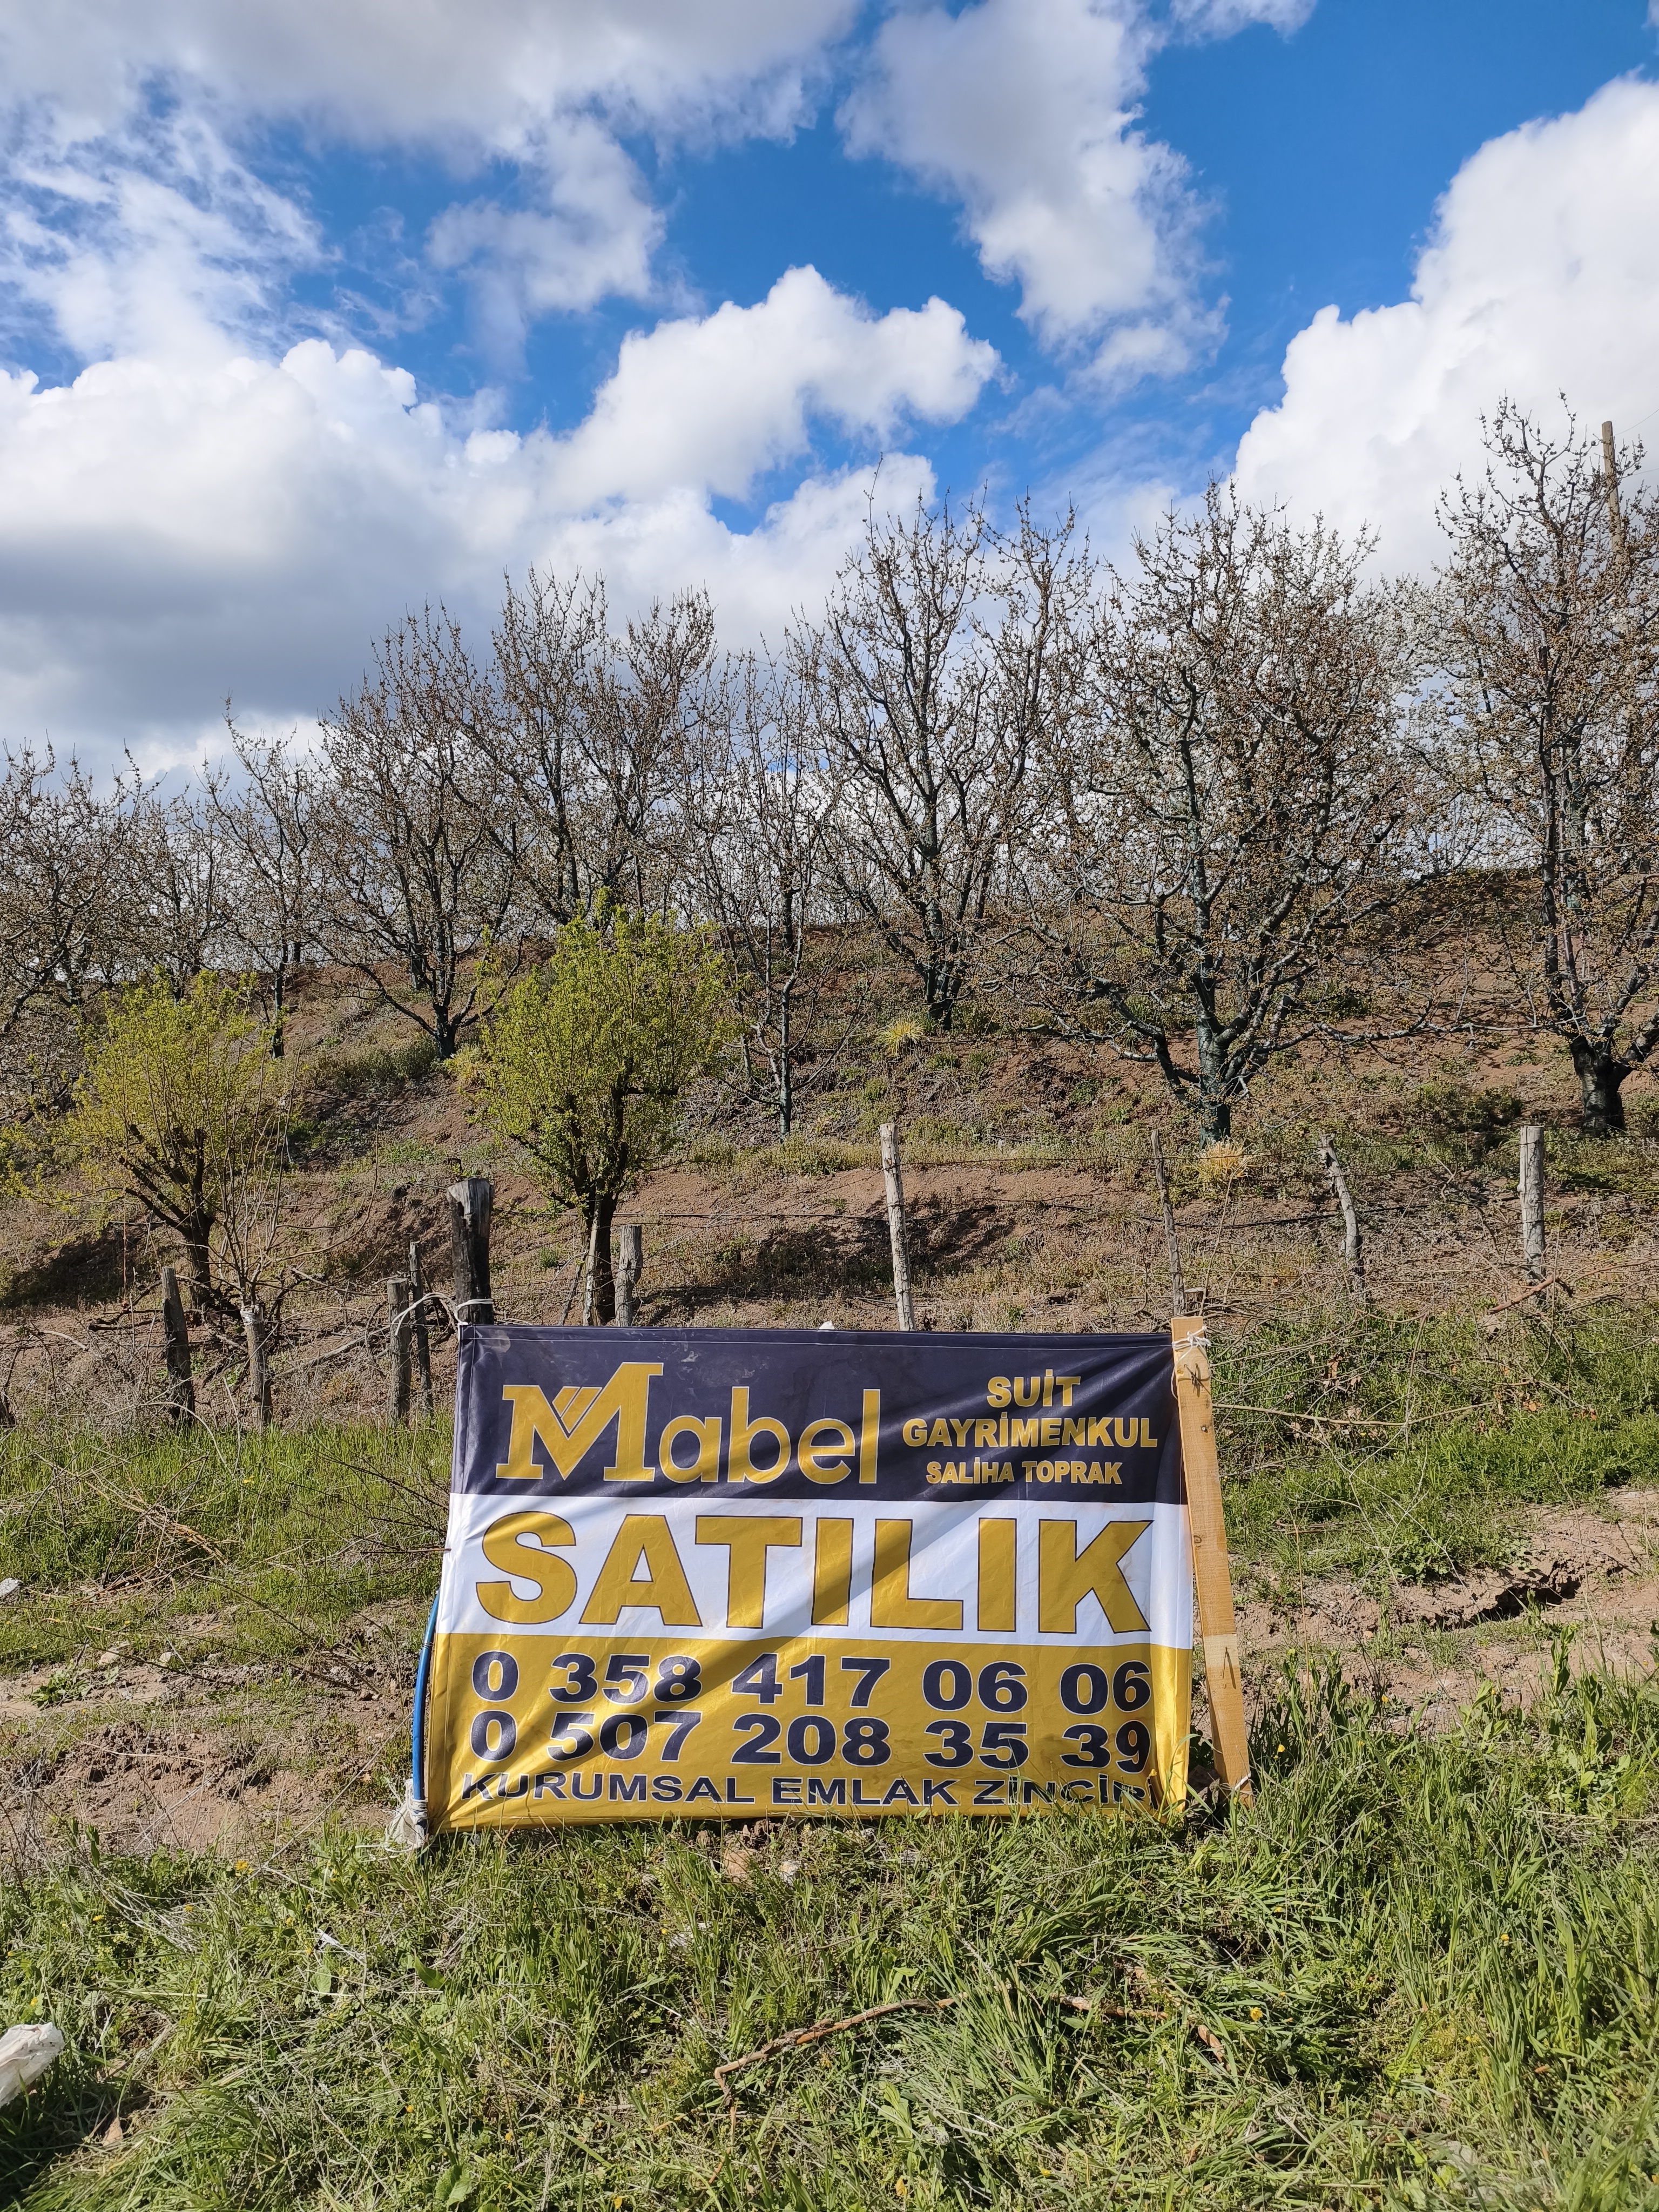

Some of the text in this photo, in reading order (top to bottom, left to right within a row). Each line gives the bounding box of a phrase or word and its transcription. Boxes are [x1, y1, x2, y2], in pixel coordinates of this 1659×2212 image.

[987, 1369, 1081, 1407] SUİT
[495, 1362, 880, 1484] Mabel
[902, 1412, 1158, 1447] GAYRİMENKUL
[926, 1457, 1123, 1484] SALİHA TOPRAK
[475, 1510, 1153, 1634] SATILIK
[471, 1650, 1152, 1716] 0 358 417 06 06
[470, 1709, 1151, 1773] 0 507 208 35 39
[461, 1771, 756, 1804] KURUMSAL
[772, 1777, 961, 1806] EMLAK
